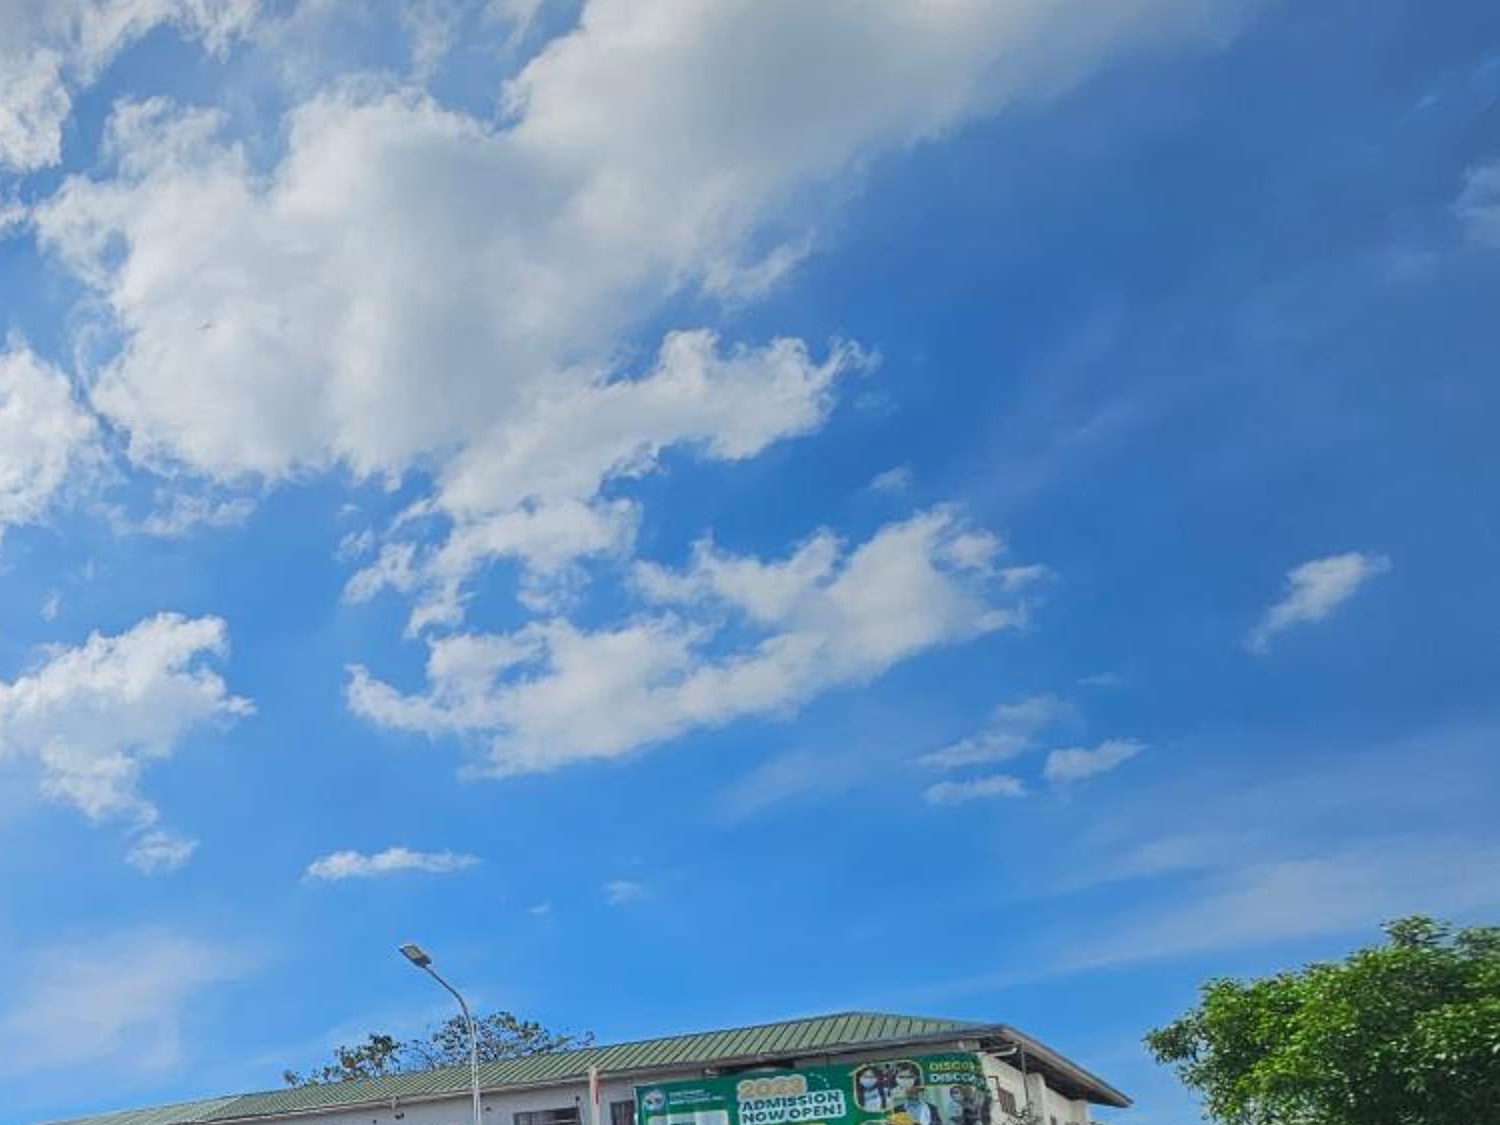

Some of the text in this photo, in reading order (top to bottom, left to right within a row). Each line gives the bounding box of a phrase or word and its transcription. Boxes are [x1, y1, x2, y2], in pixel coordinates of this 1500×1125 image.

[742, 1092, 840, 1112] ADMISSION
[742, 1104, 842, 1124] NOW OPEN!
